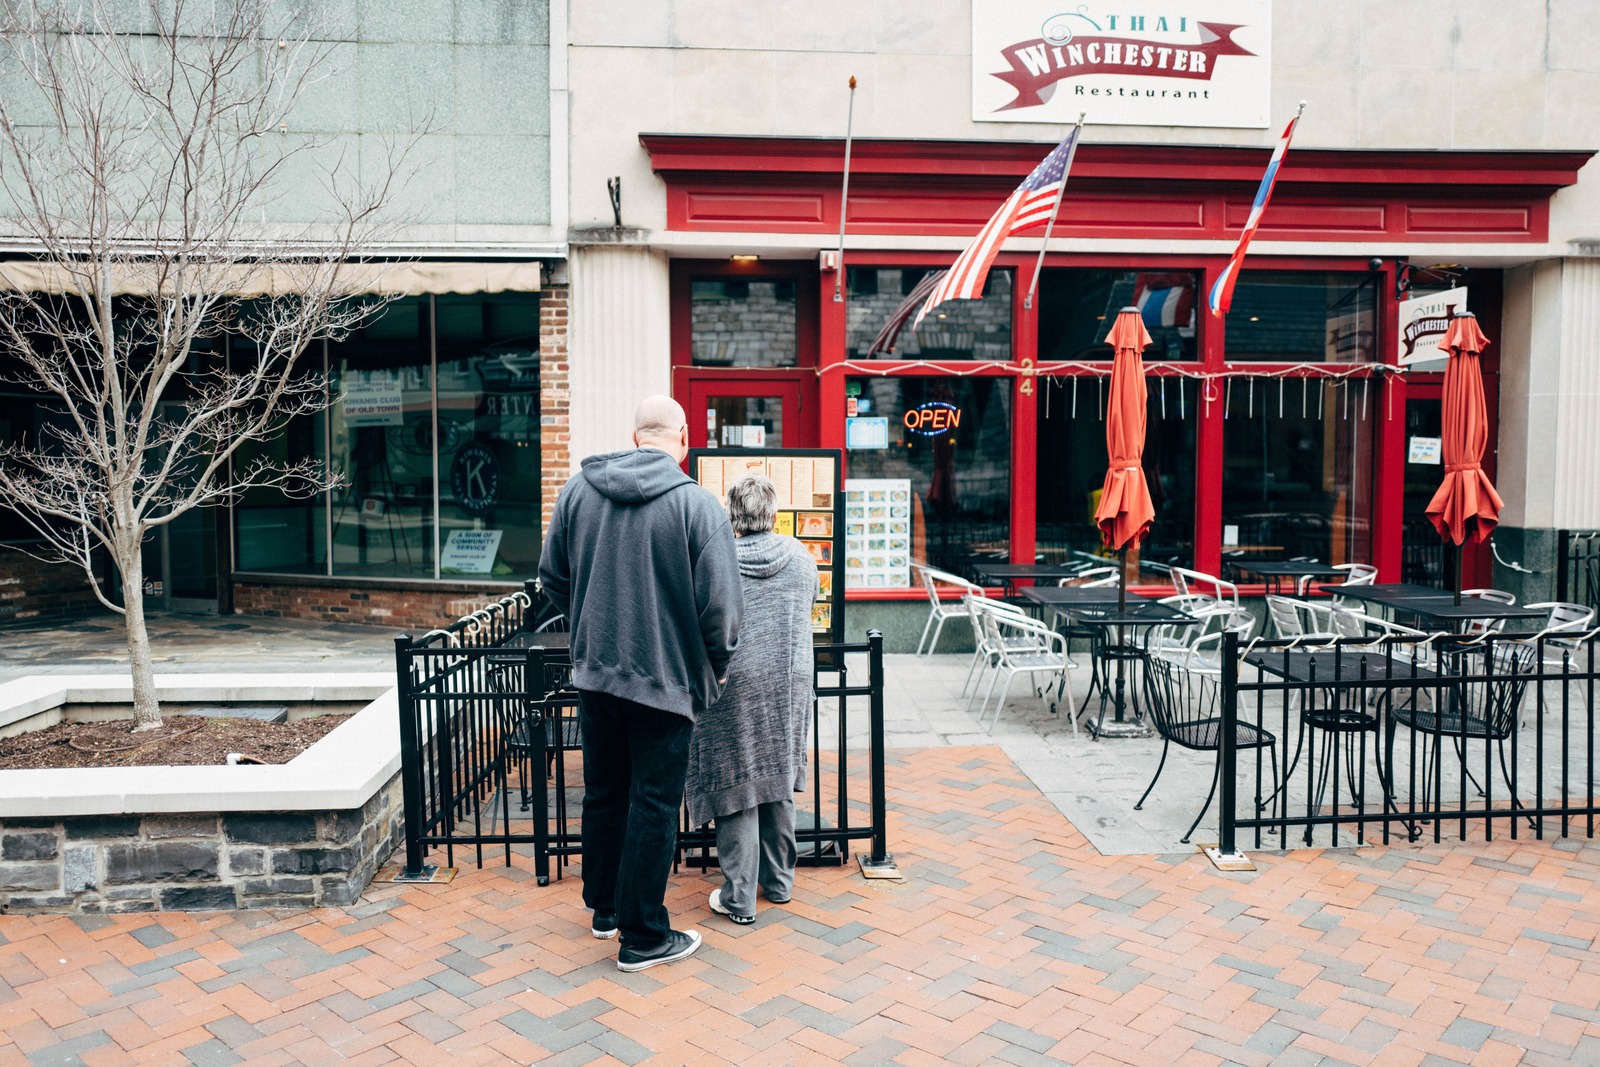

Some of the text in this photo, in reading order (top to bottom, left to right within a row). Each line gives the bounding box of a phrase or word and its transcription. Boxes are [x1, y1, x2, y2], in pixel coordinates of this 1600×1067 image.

[1106, 14, 1188, 33] THAI
[1074, 85, 1211, 99] Restaurant
[1426, 303, 1445, 315] THAI
[344, 396, 401, 405] KIWANIS CLUB
[376, 405, 400, 413] TOWN
[904, 409, 961, 429] OPEN
